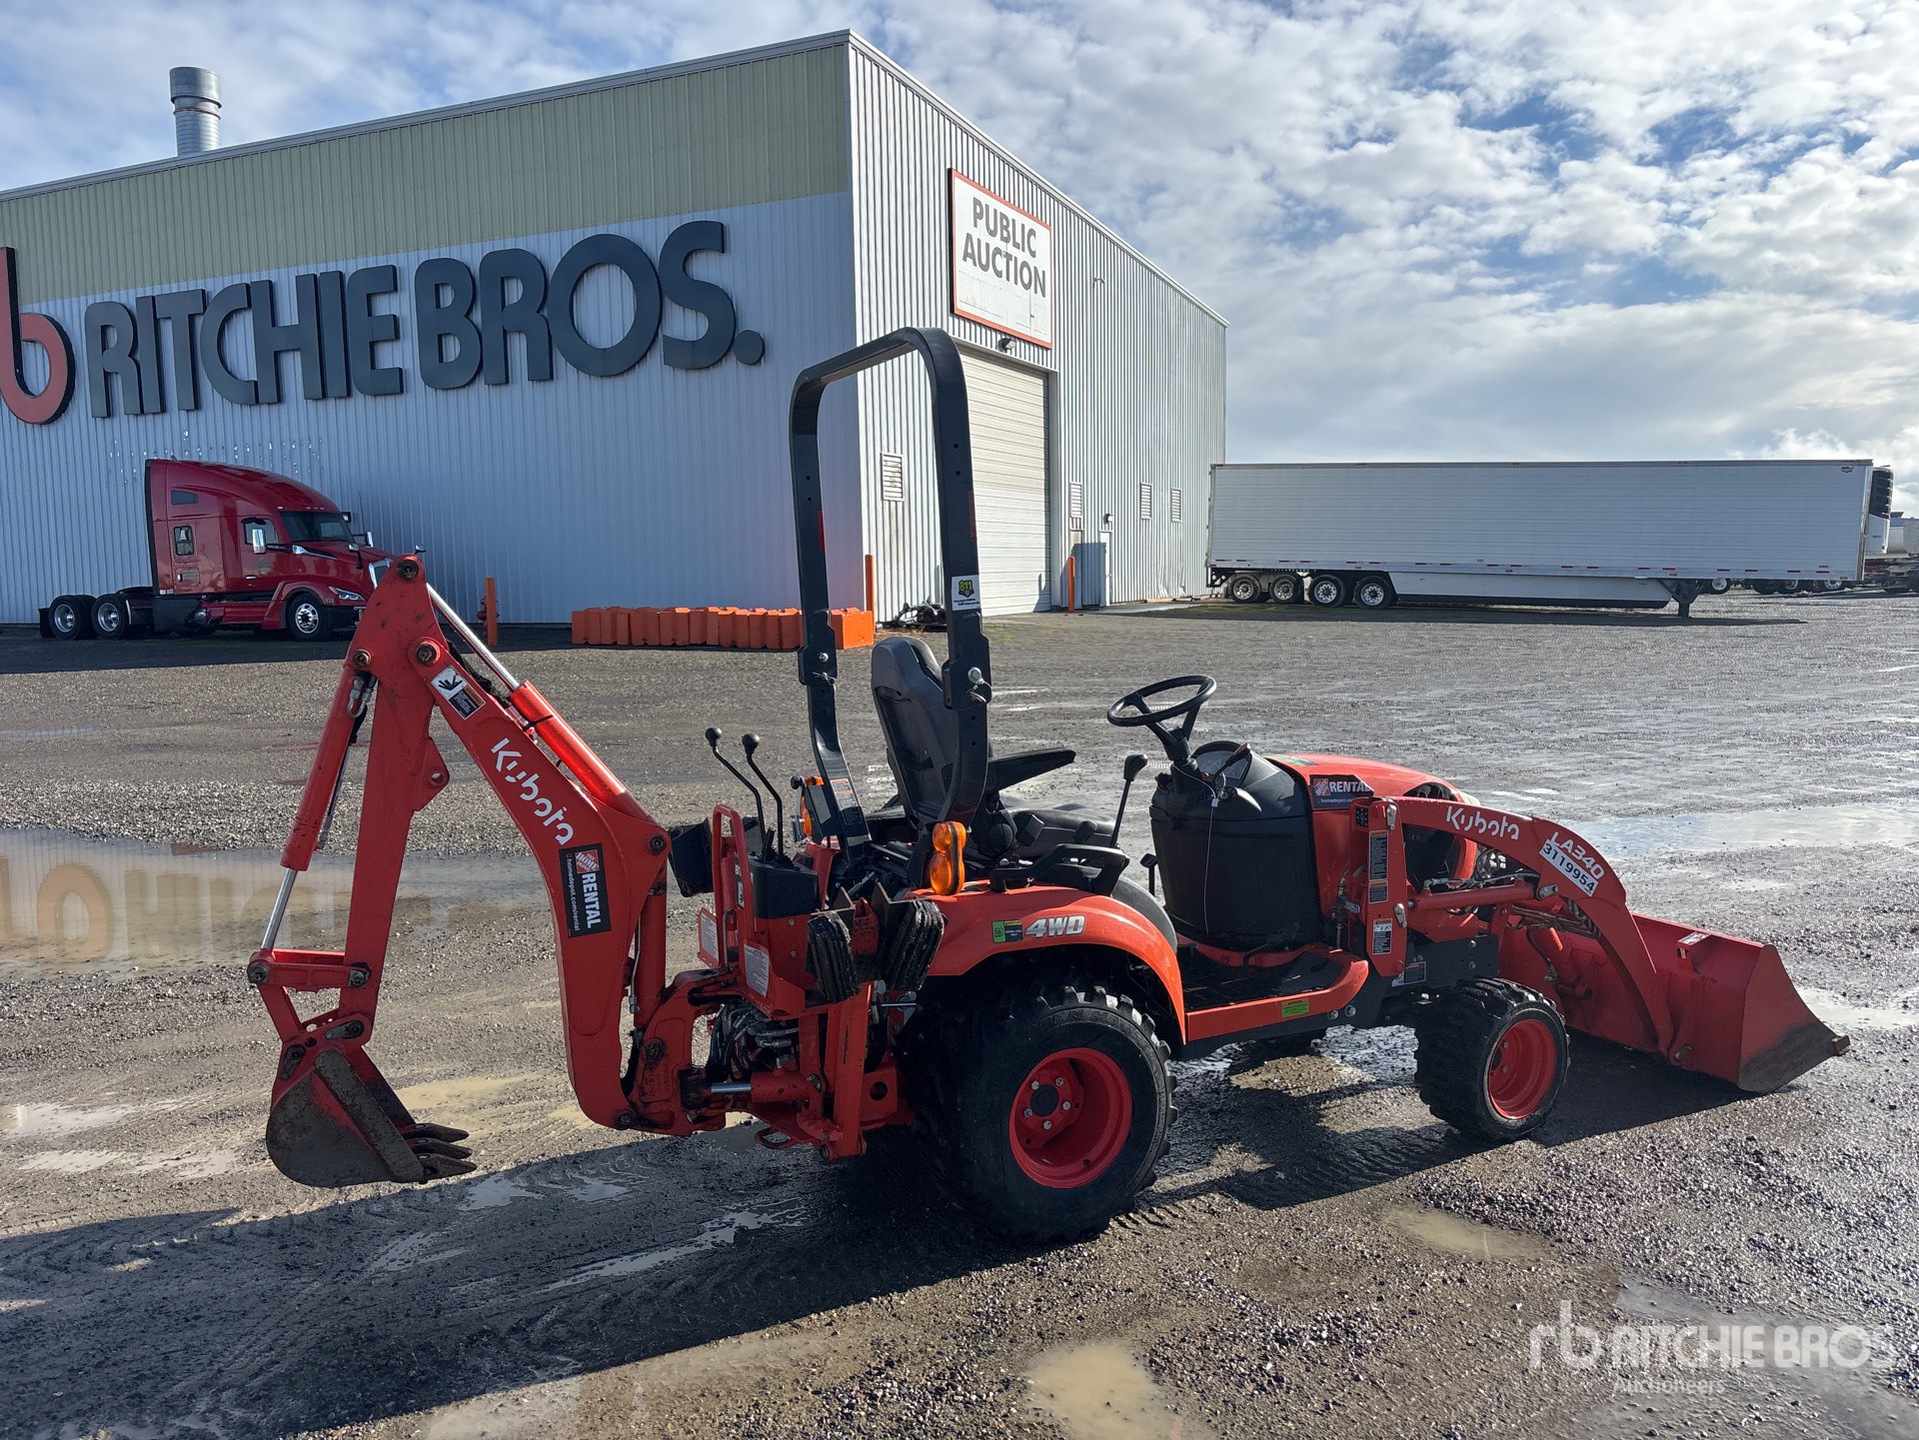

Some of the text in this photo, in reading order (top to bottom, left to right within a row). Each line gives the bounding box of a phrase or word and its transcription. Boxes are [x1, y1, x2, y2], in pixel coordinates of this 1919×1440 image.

[973, 197, 1036, 258] PUBLIC
[962, 233, 1046, 298] AUCTION
[85, 265, 404, 419] RITCHIE
[415, 220, 765, 390] BROS.
[491, 737, 574, 846] Kubota
[1329, 781, 1372, 792] RENTAL
[1446, 806, 1519, 840] Kubota
[1543, 843, 1595, 892] 3119954
[1550, 831, 1605, 880] LA340
[582, 873, 601, 929] RENTAL
[1025, 915, 1085, 938] 4WD
